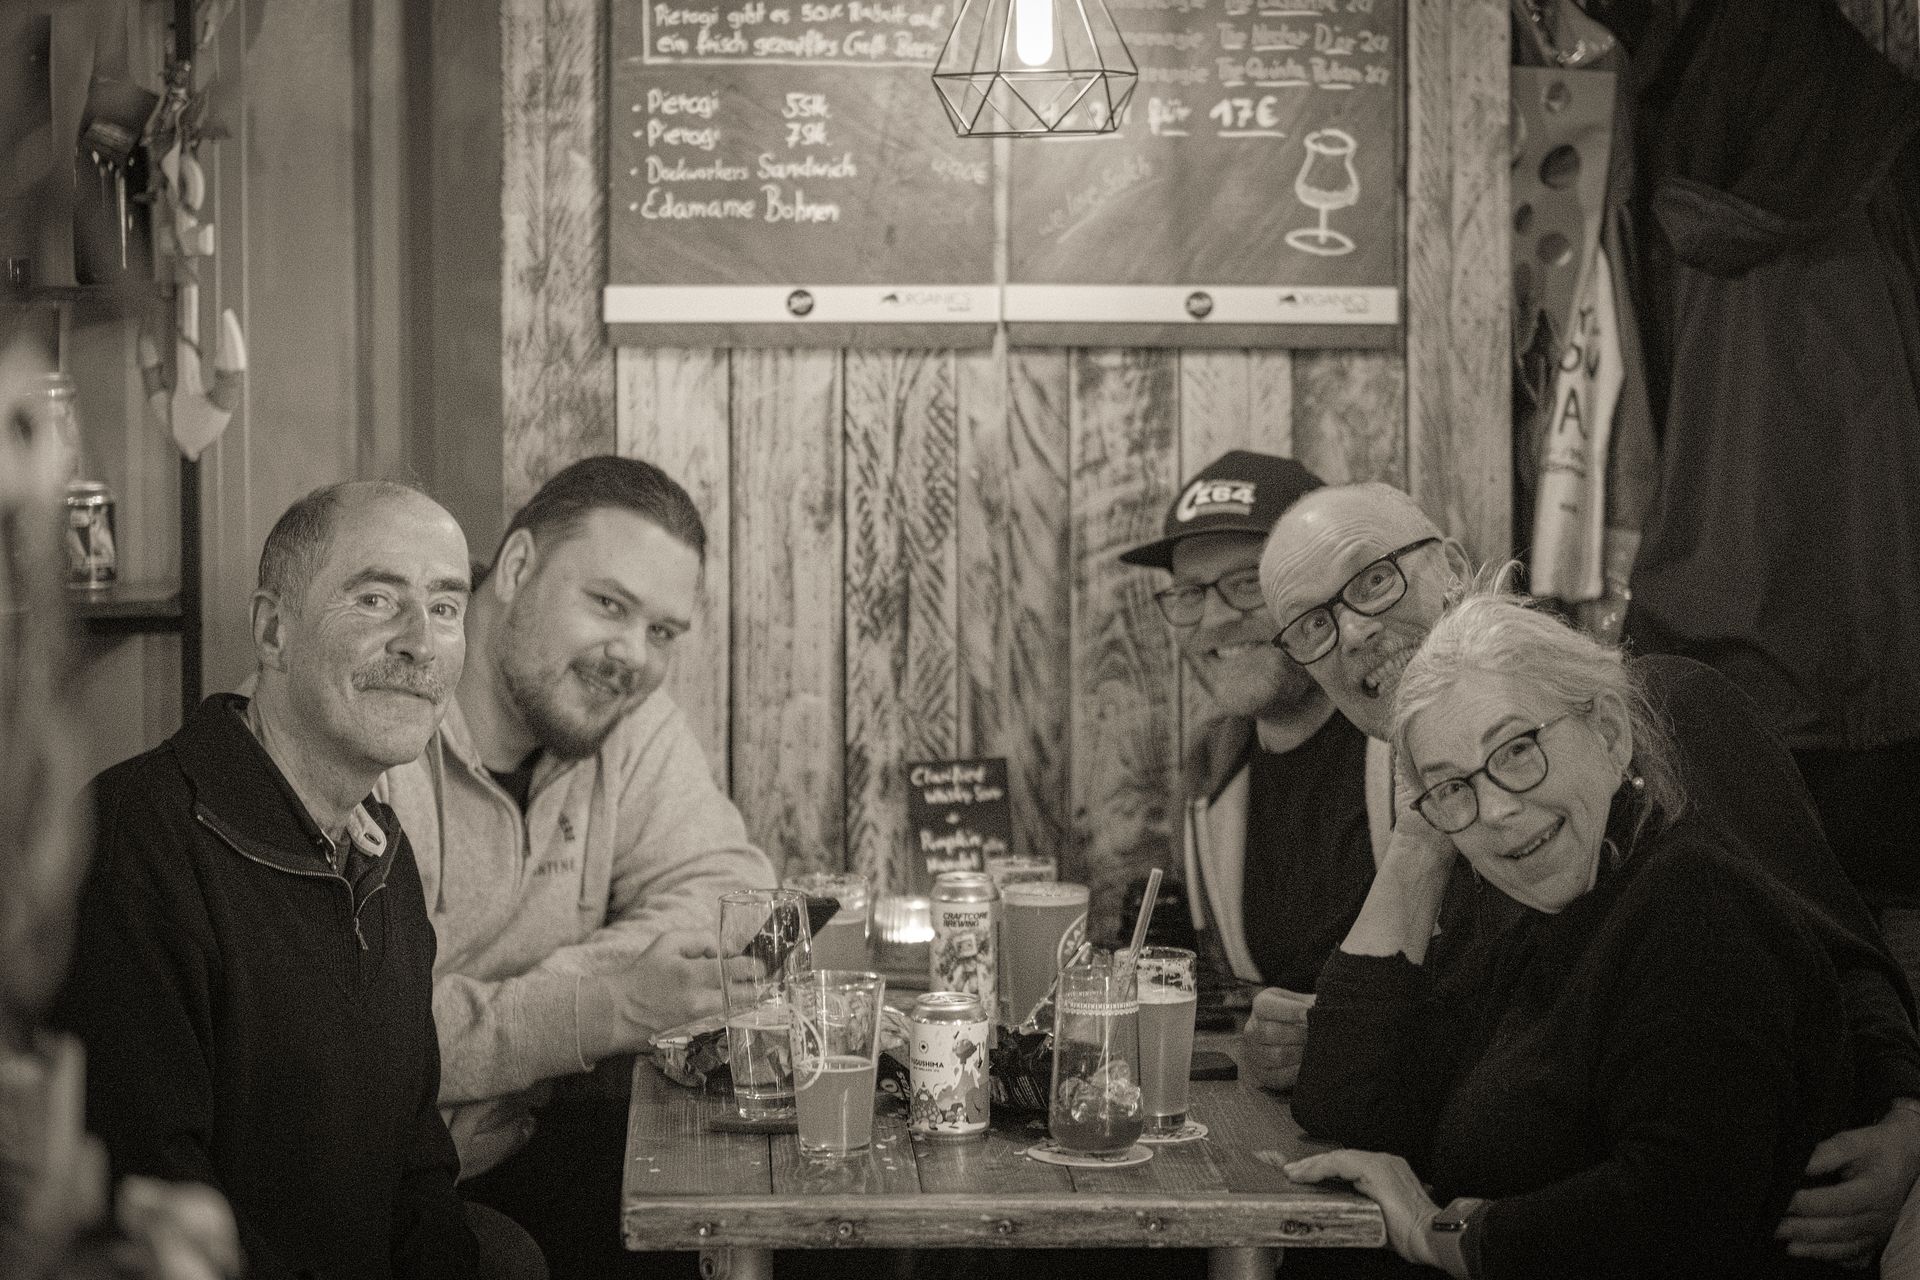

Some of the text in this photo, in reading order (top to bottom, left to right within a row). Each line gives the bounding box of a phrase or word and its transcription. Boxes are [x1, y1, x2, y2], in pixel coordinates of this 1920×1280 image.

[769, 9, 791, 24] es
[656, 32, 689, 54] ein
[1209, 95, 1280, 128] 17€
[757, 151, 857, 180] Sandwich
[641, 184, 841, 223] Edamame Bohnen
